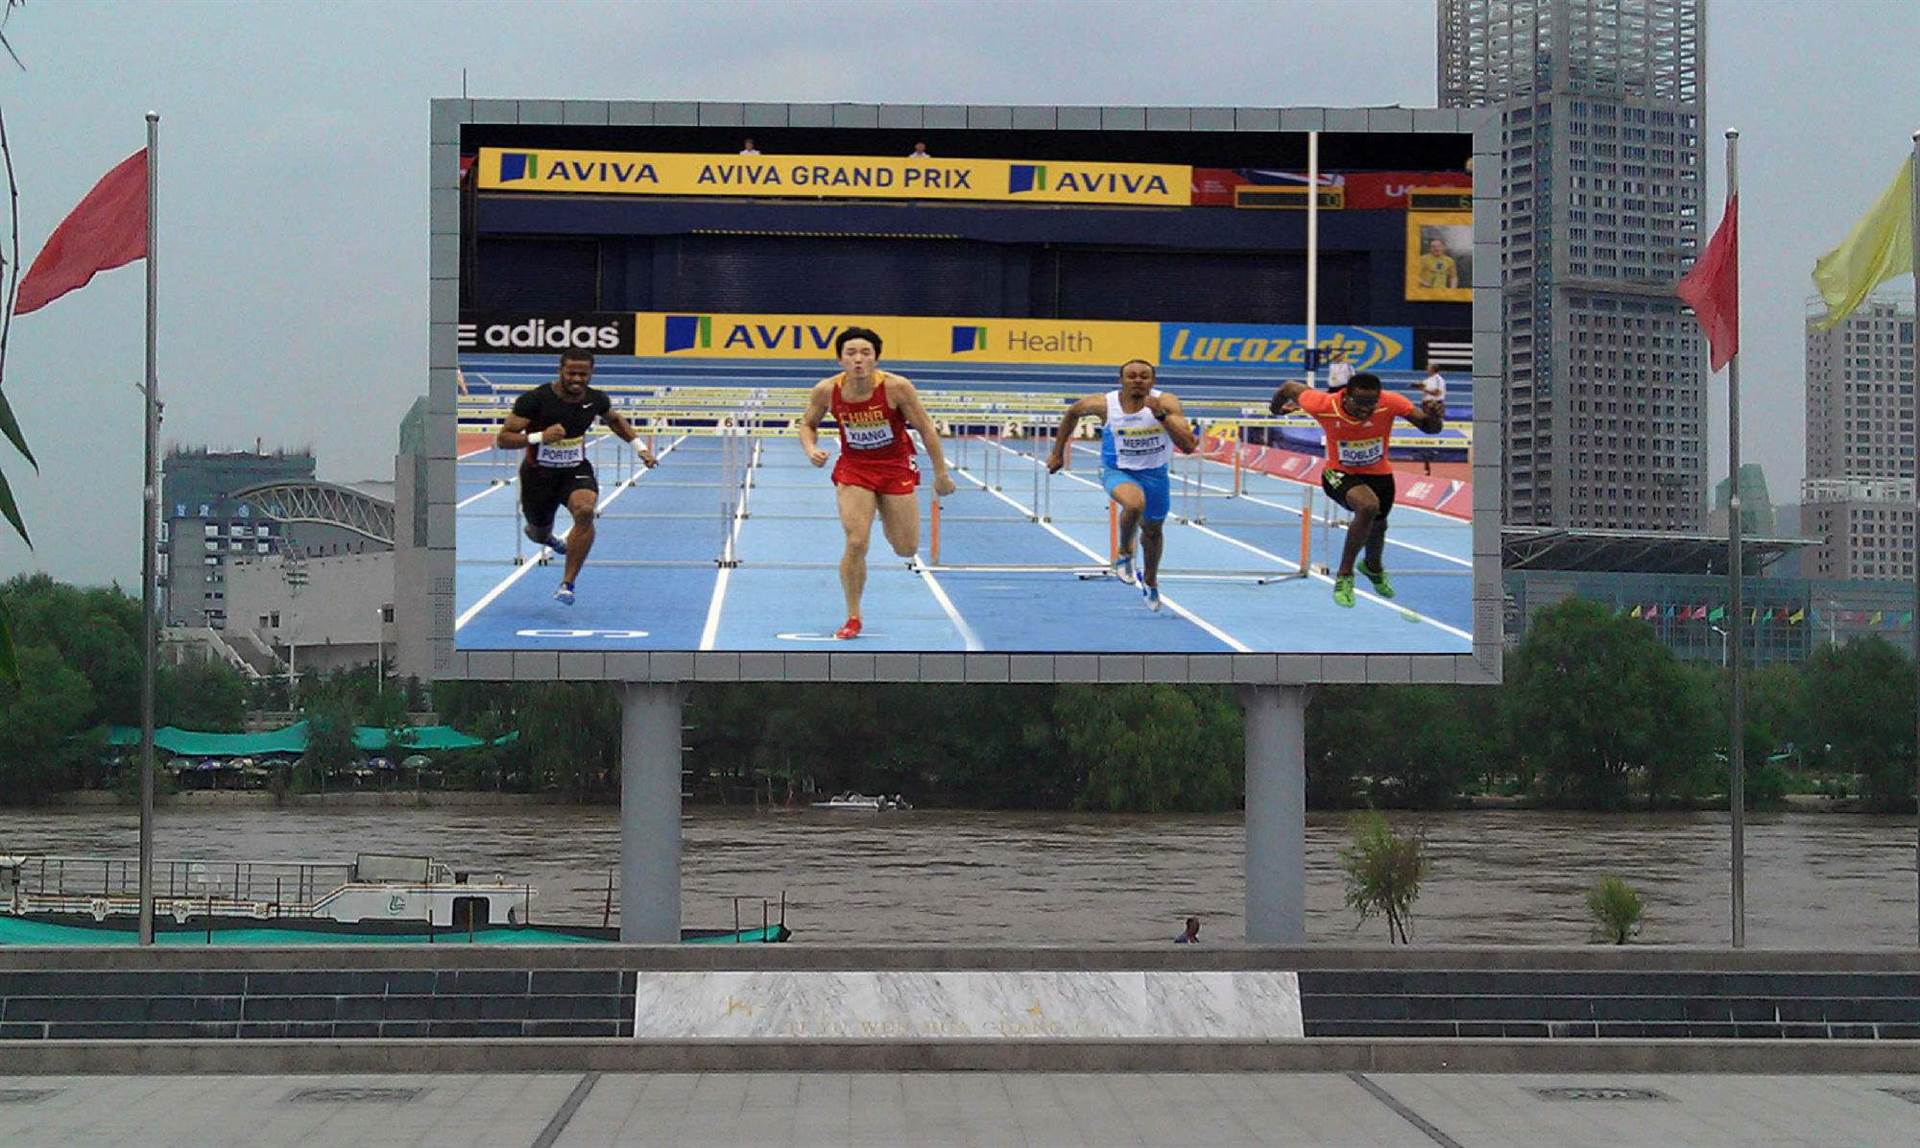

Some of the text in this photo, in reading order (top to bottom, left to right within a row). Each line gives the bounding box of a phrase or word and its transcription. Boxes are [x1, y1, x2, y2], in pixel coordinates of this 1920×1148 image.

[546, 160, 659, 184] AVIVA
[697, 164, 972, 190] AVIVA GRAND PRIX
[1056, 172, 1169, 195] AVIVA
[484, 318, 620, 349] adidas
[723, 324, 838, 350] AVIV
[1008, 330, 1093, 353] Health
[849, 429, 887, 442] XIANG
[1122, 436, 1160, 448] MERRITT
[542, 447, 579, 460] PORTER
[1343, 445, 1380, 460] ROBLES
